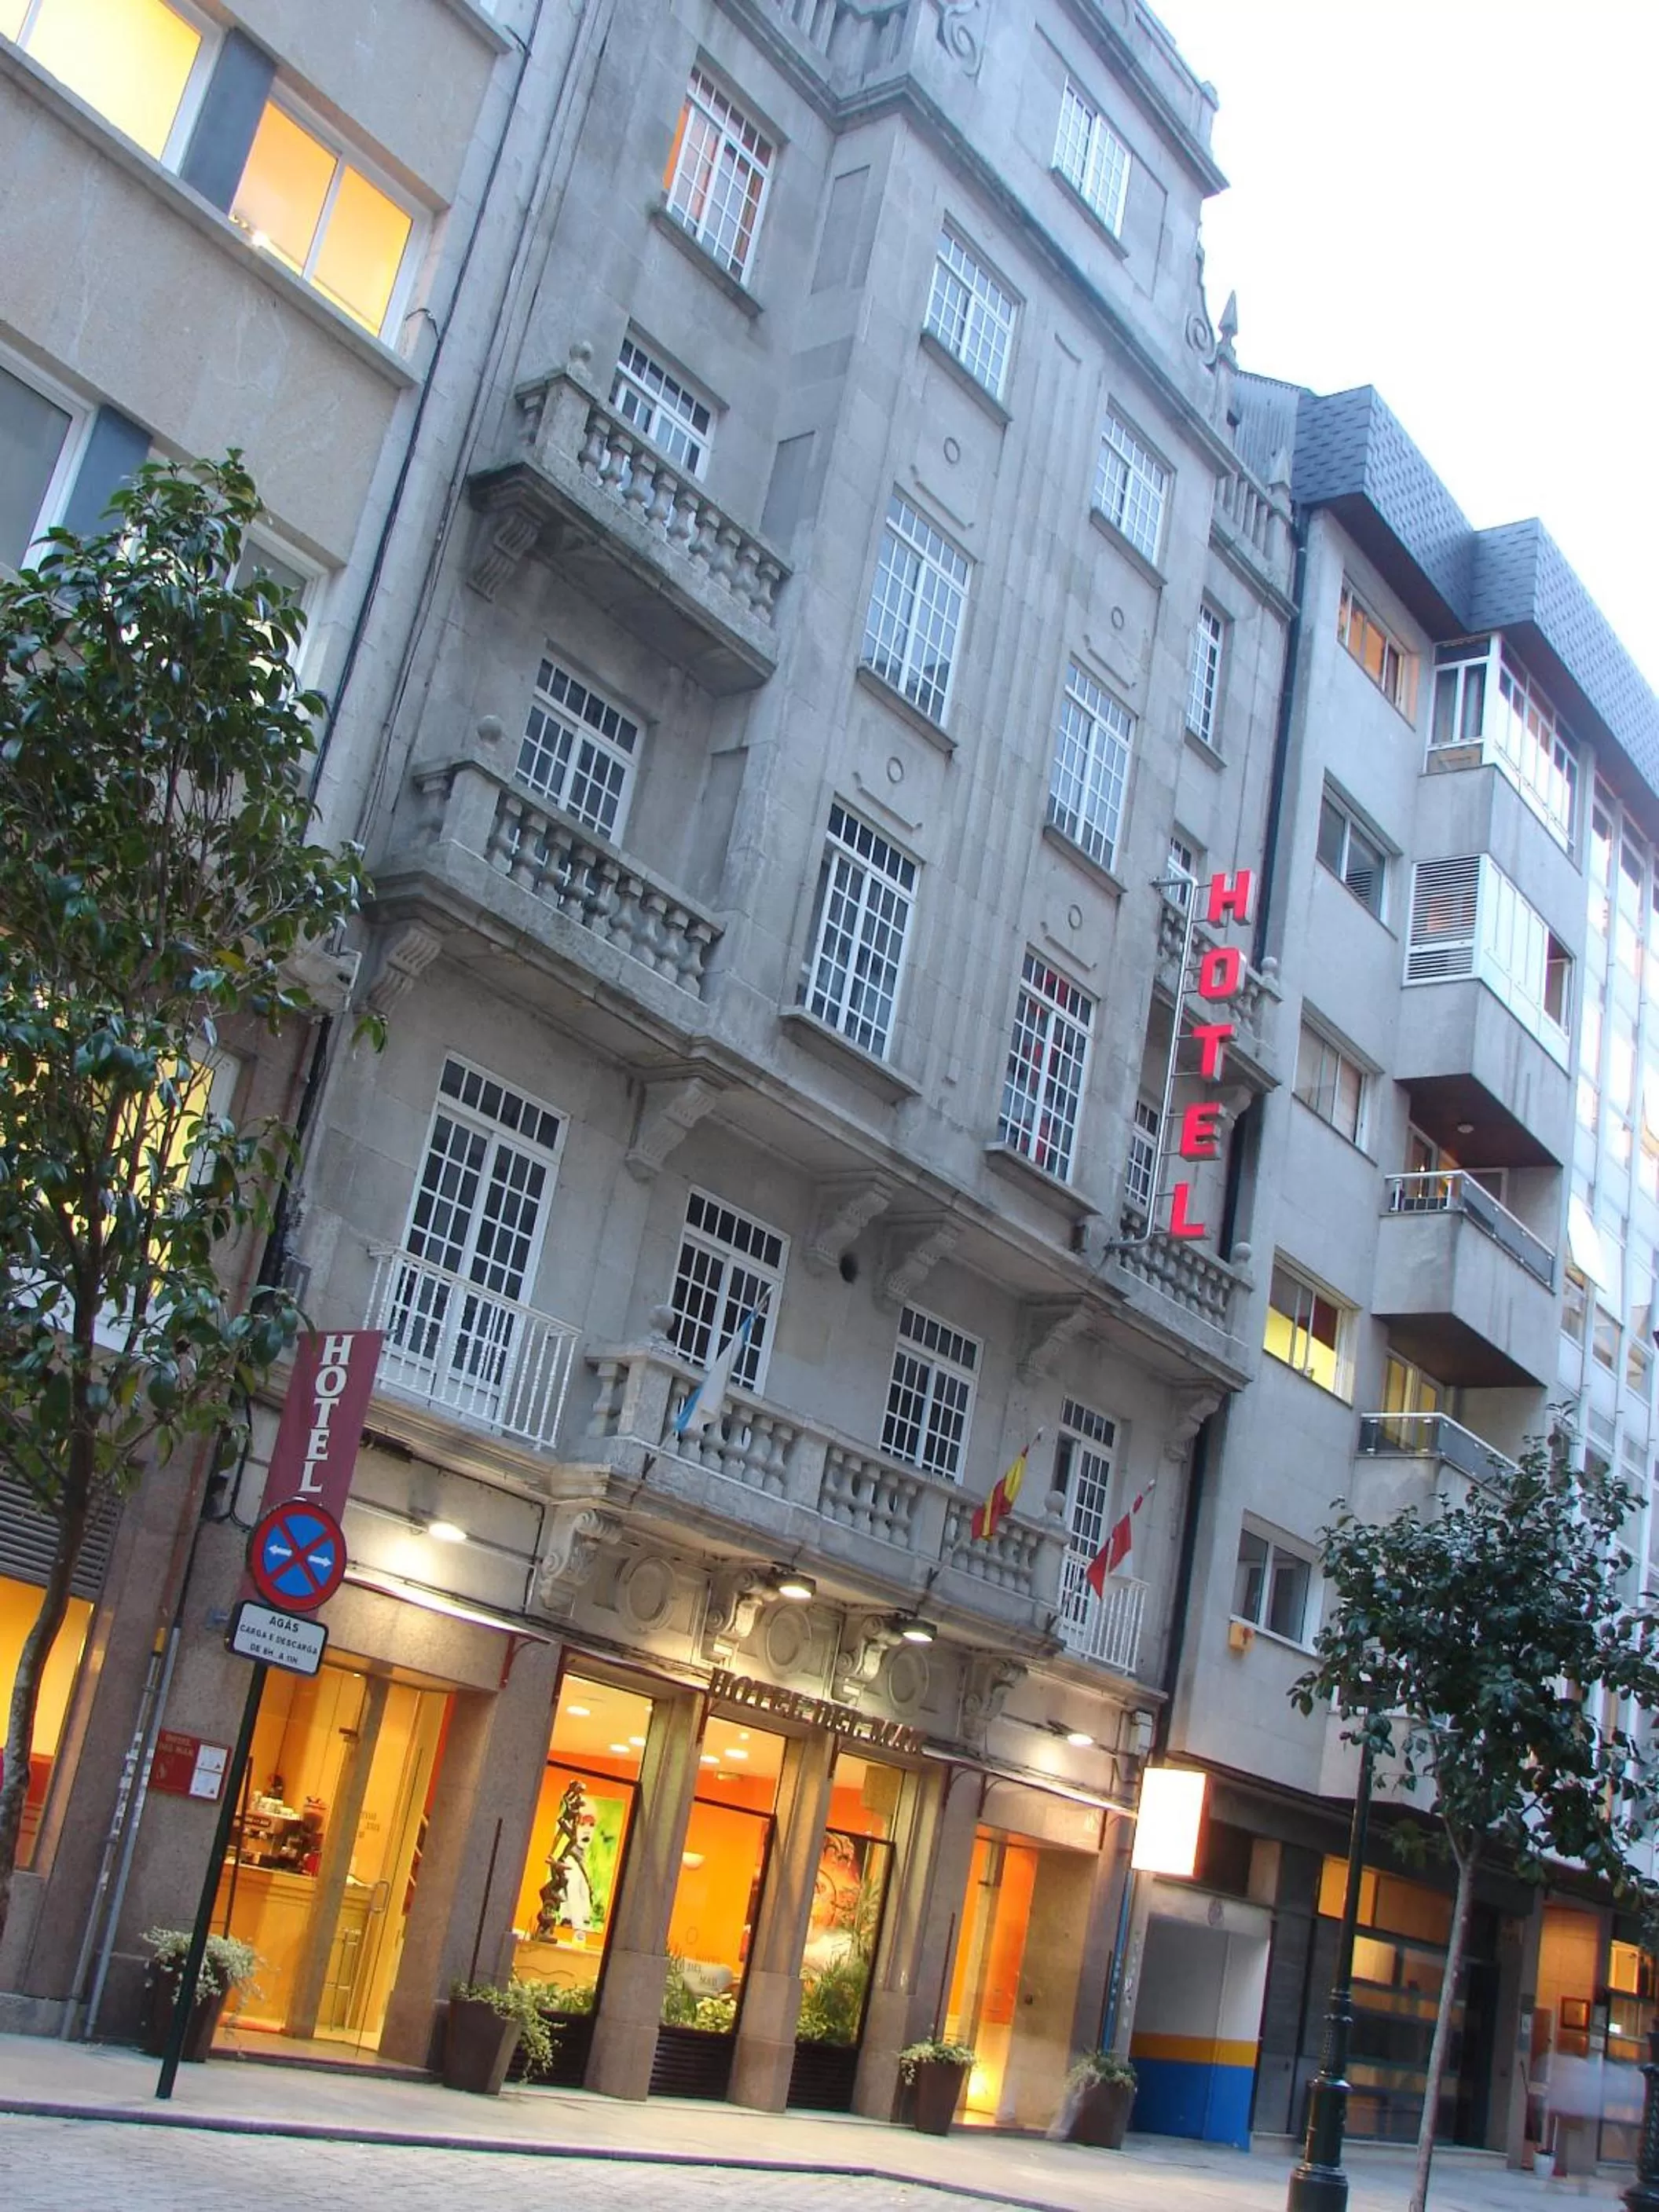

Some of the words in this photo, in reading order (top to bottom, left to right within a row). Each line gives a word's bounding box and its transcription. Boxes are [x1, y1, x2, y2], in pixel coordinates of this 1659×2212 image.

[1170, 869, 1253, 1239] HOTEL
[298, 1335, 354, 1492] HOTEL
[240, 1624, 267, 1639] CARGA
[269, 1633, 274, 1643] E
[275, 1635, 317, 1655] DESCARGA
[250, 1643, 261, 1654] DE
[708, 1668, 815, 1723] HOTEL
[812, 1697, 868, 1739] DEL
